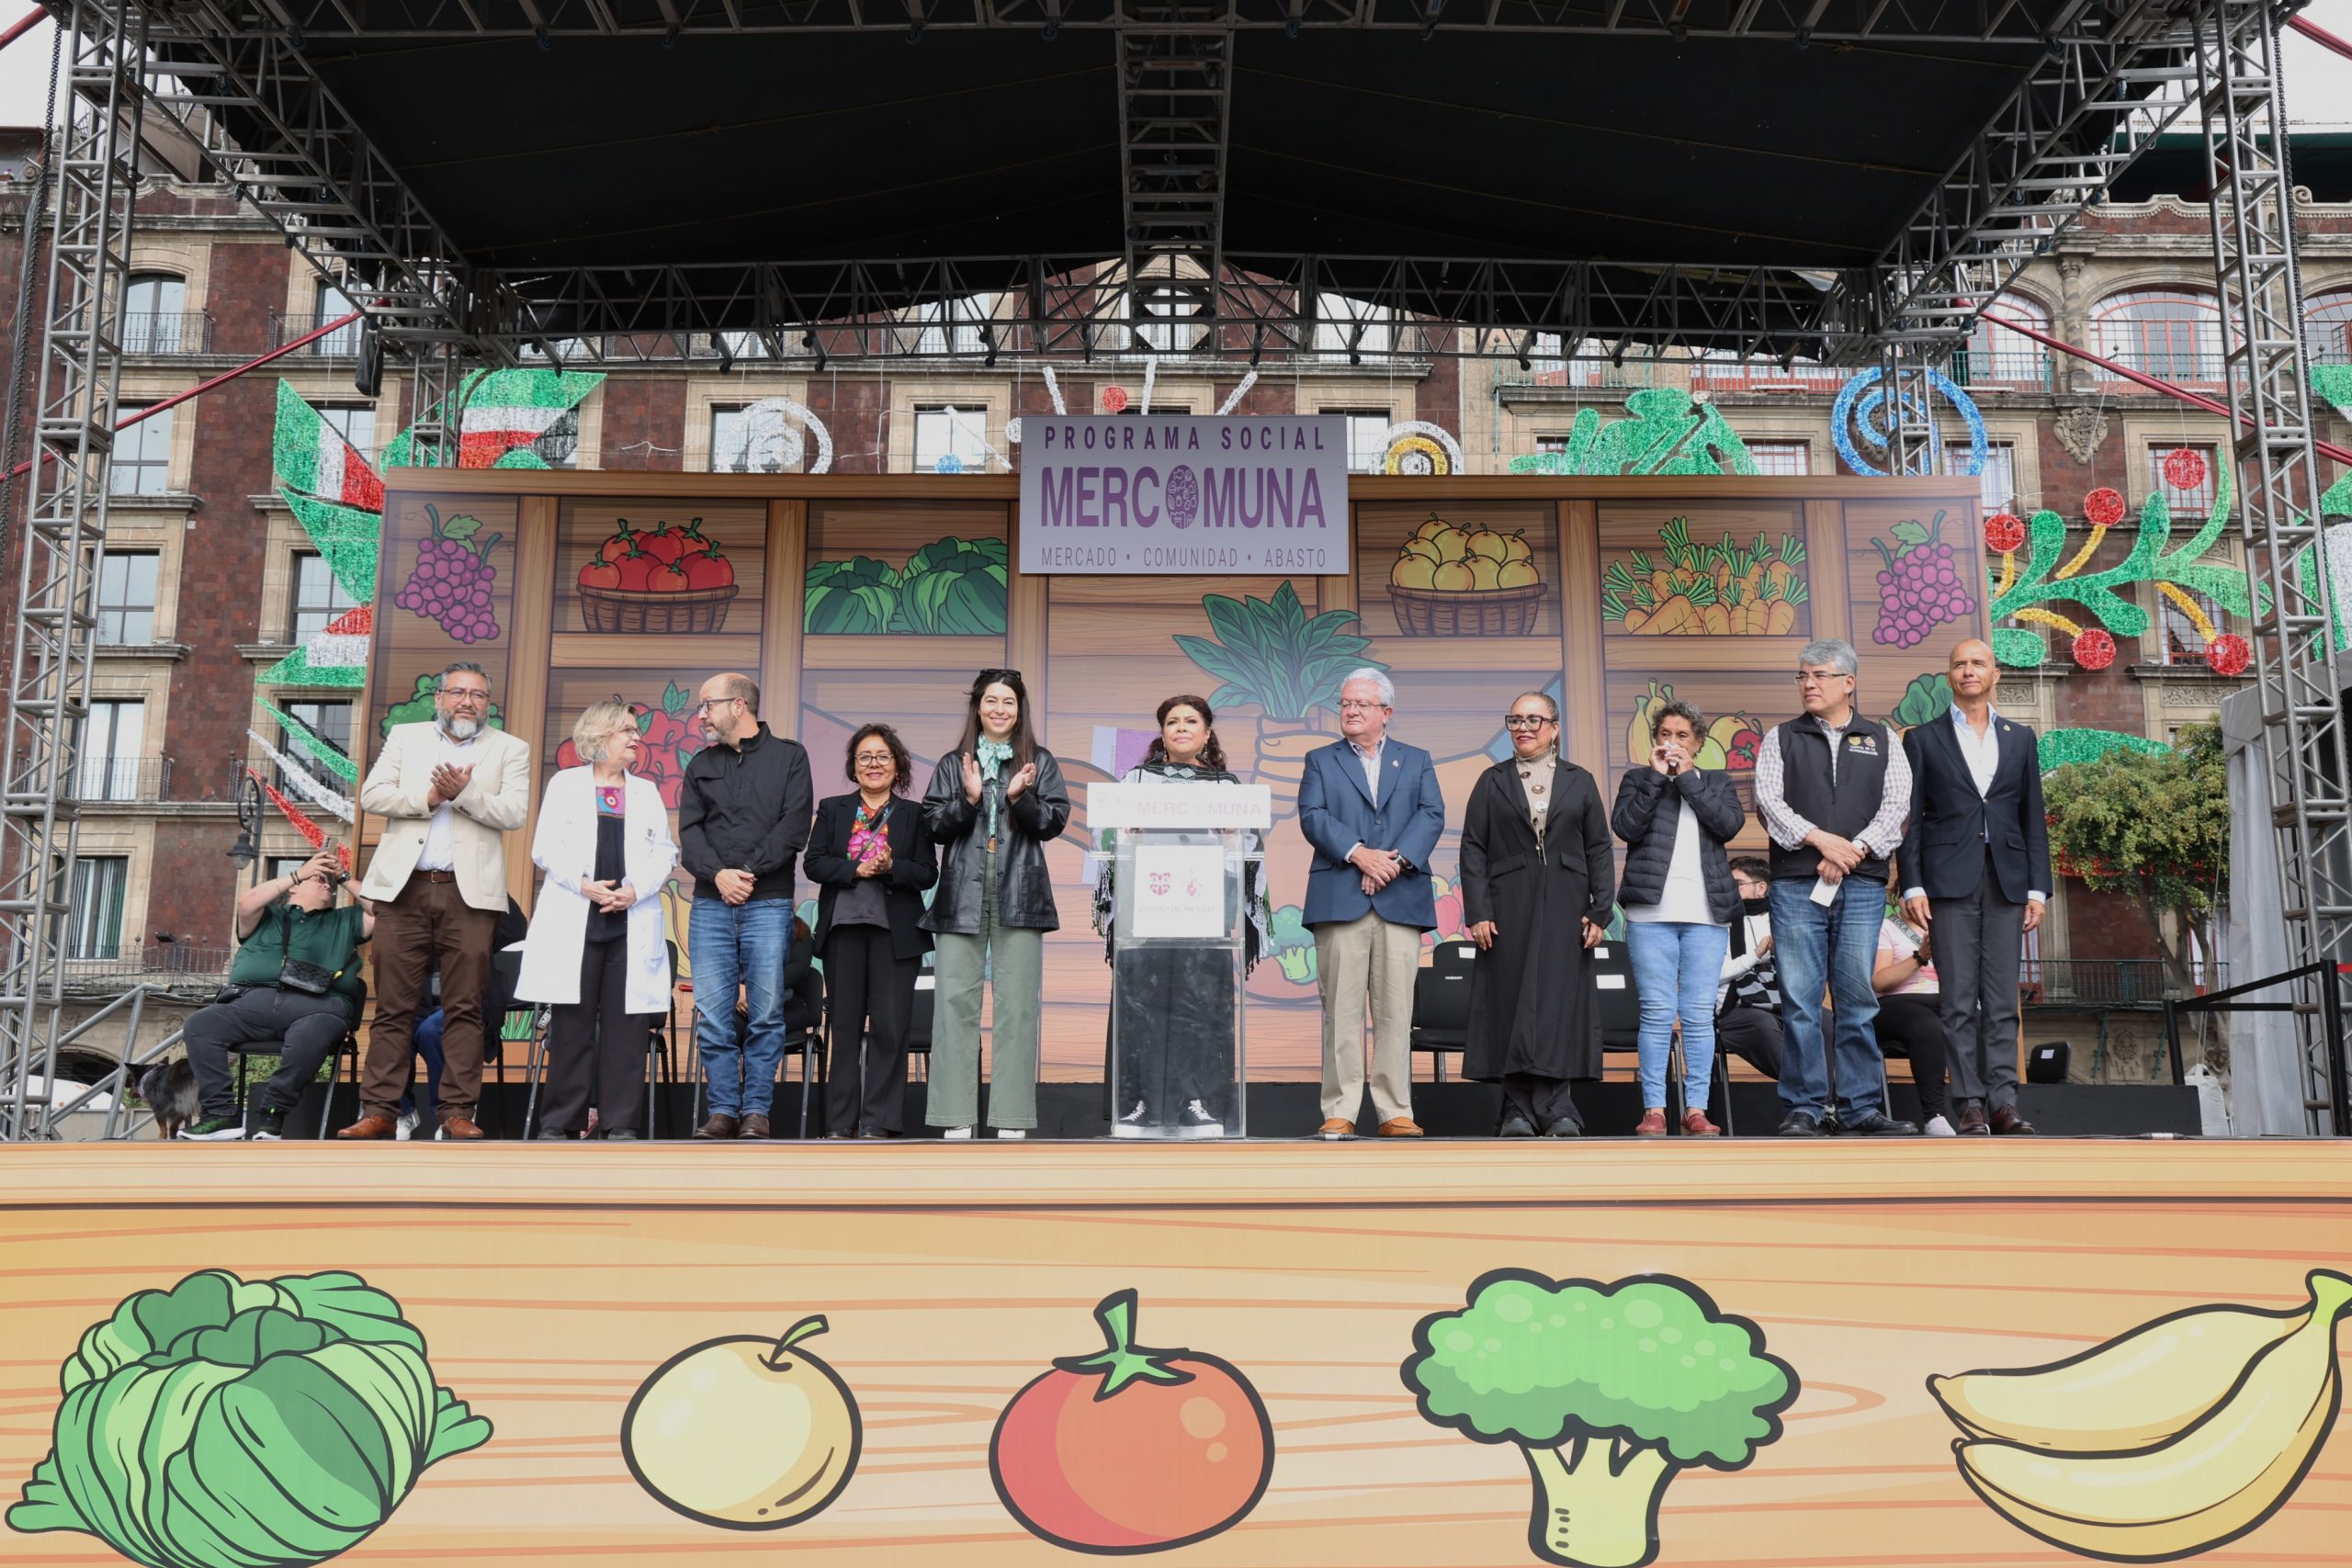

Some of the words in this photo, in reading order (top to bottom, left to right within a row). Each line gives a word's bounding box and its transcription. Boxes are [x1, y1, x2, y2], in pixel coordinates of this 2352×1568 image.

[1045, 425, 1200, 450] PROGRAMA
[1220, 426, 1324, 450] SOCIAL
[1040, 464, 1327, 529] MERCOMUNA
[1041, 547, 1116, 567] MERCADO
[1143, 547, 1238, 567] COMUNIDAD
[1264, 548, 1326, 568] ABASTO
[1136, 801, 1262, 816] MERCMUNA
